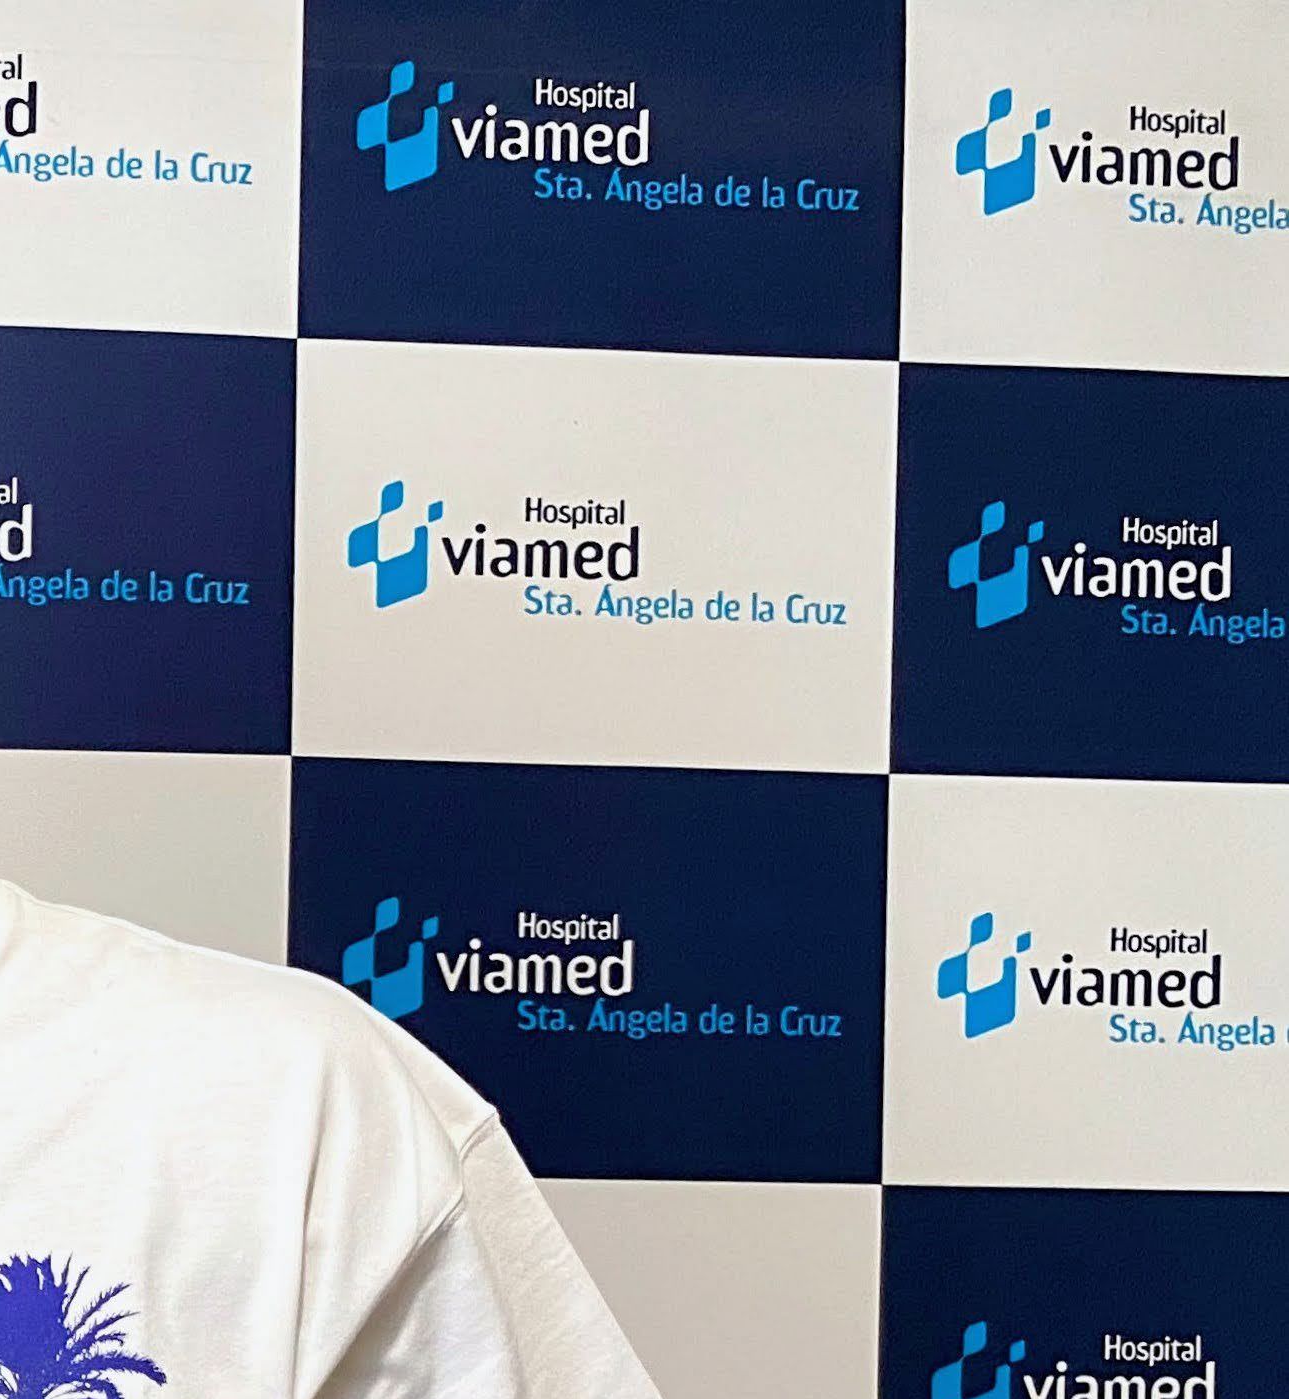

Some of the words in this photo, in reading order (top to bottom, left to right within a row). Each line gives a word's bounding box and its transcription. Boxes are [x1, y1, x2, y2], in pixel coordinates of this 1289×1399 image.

[535, 78, 636, 114] Hospital
[451, 104, 650, 167] viamed
[1130, 105, 1226, 139] Hospital
[106, 150, 143, 179] de
[154, 151, 180, 181] la
[189, 151, 253, 186] Cruz
[1048, 130, 1239, 191] viamed
[533, 167, 592, 200] Sta.
[604, 168, 704, 211] Ángela
[715, 177, 751, 207] de
[762, 178, 786, 209] la
[796, 177, 858, 212] Cruz
[1129, 193, 1184, 225] Sta.
[525, 496, 625, 530] Hospital
[441, 523, 640, 582] viamed
[1122, 516, 1218, 551] Hospital
[100, 572, 140, 601] de
[149, 572, 175, 603] la
[184, 572, 248, 605] Cruz
[1041, 542, 1232, 602] viamed
[524, 583, 582, 616] Sta.
[595, 584, 695, 625] Ángela
[704, 592, 740, 621] de
[750, 594, 776, 623] la
[785, 593, 846, 626] Cruz
[1121, 604, 1177, 635] Sta.
[1189, 604, 1287, 643] Ángela
[518, 911, 619, 946] Hospital
[1110, 927, 1208, 959] Hospital
[436, 938, 634, 997] viamed
[1029, 953, 1222, 1010] viamed
[516, 999, 575, 1031] Sta.
[587, 998, 688, 1040] Ángela
[698, 1005, 736, 1034] de
[746, 1005, 770, 1035] la
[780, 1005, 841, 1037] Cruz
[1109, 1013, 1166, 1044] Sta.
[1177, 1013, 1276, 1053] Ángela
[1104, 1334, 1202, 1367] Hospital
